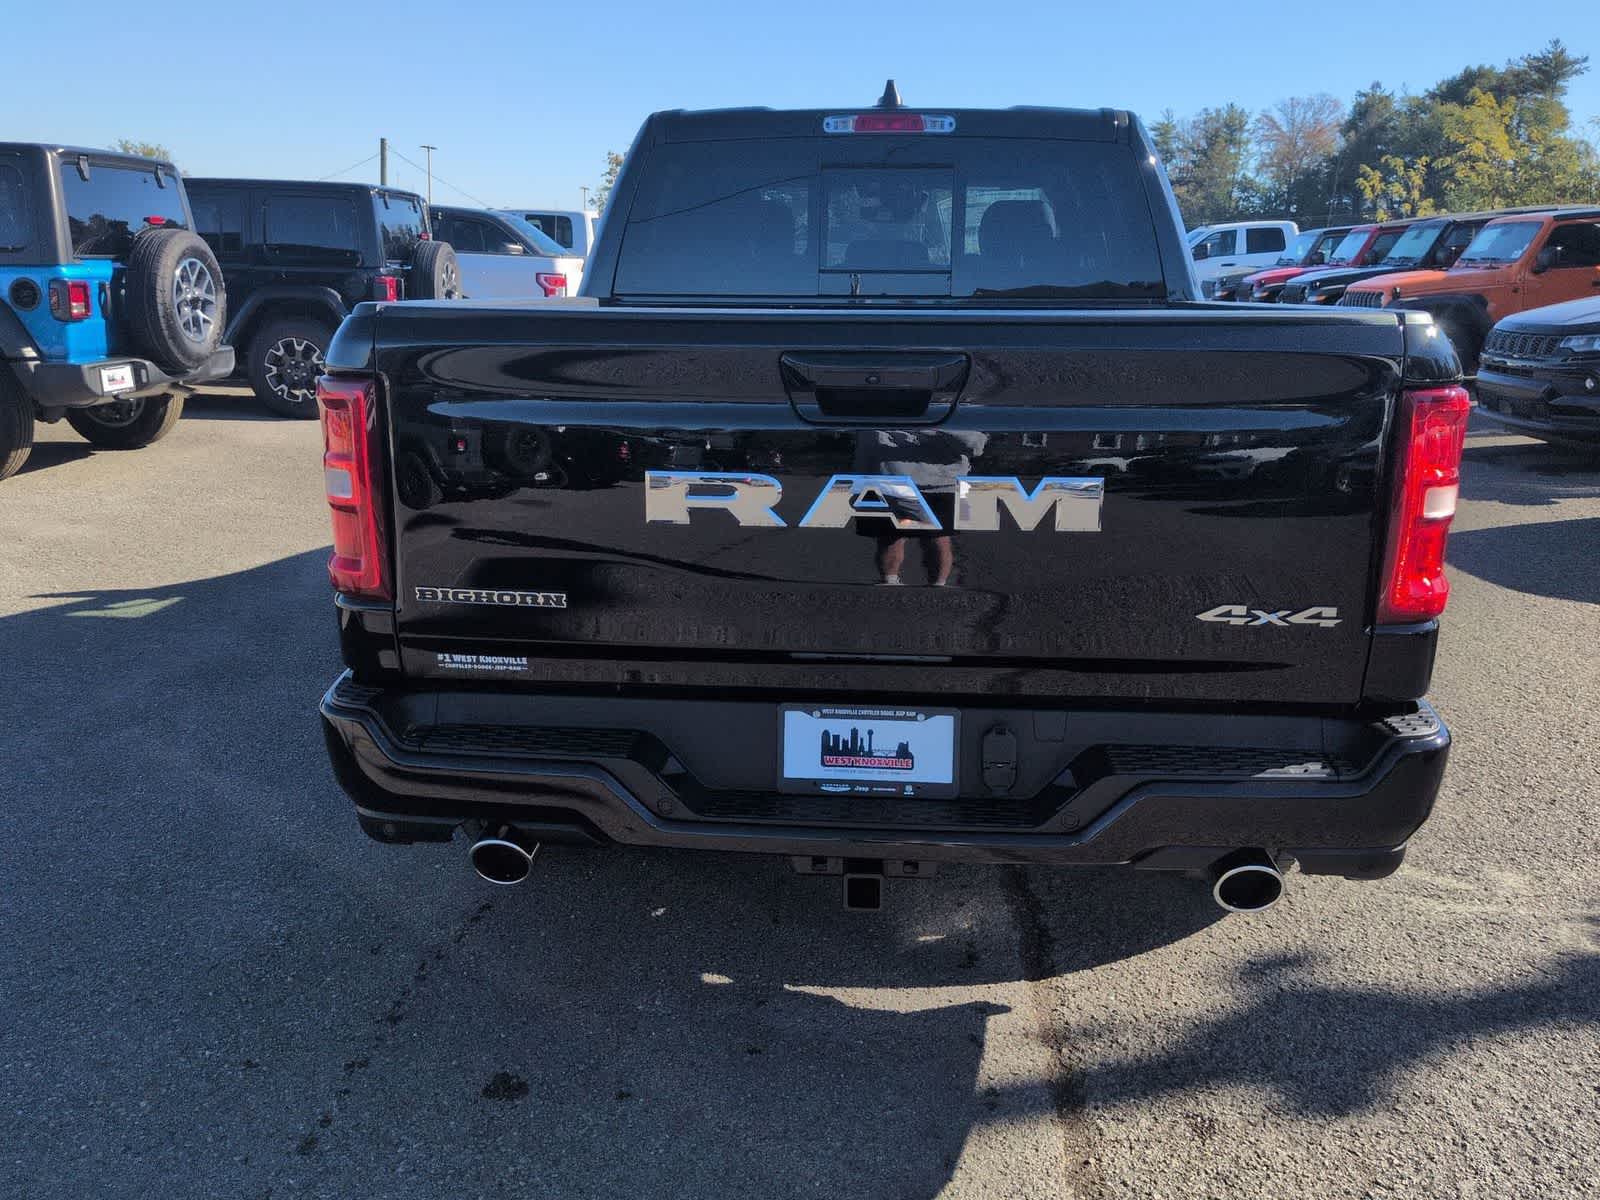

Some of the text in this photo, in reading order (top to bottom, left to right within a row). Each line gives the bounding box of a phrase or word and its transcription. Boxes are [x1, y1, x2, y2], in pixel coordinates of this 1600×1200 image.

[645, 470, 1105, 532] RAM
[1195, 604, 1343, 628] 4x4
[452, 654, 477, 663] WEST
[479, 656, 528, 665] KNOXVILLE
[824, 755, 912, 769] WEST KNOXVILLE
